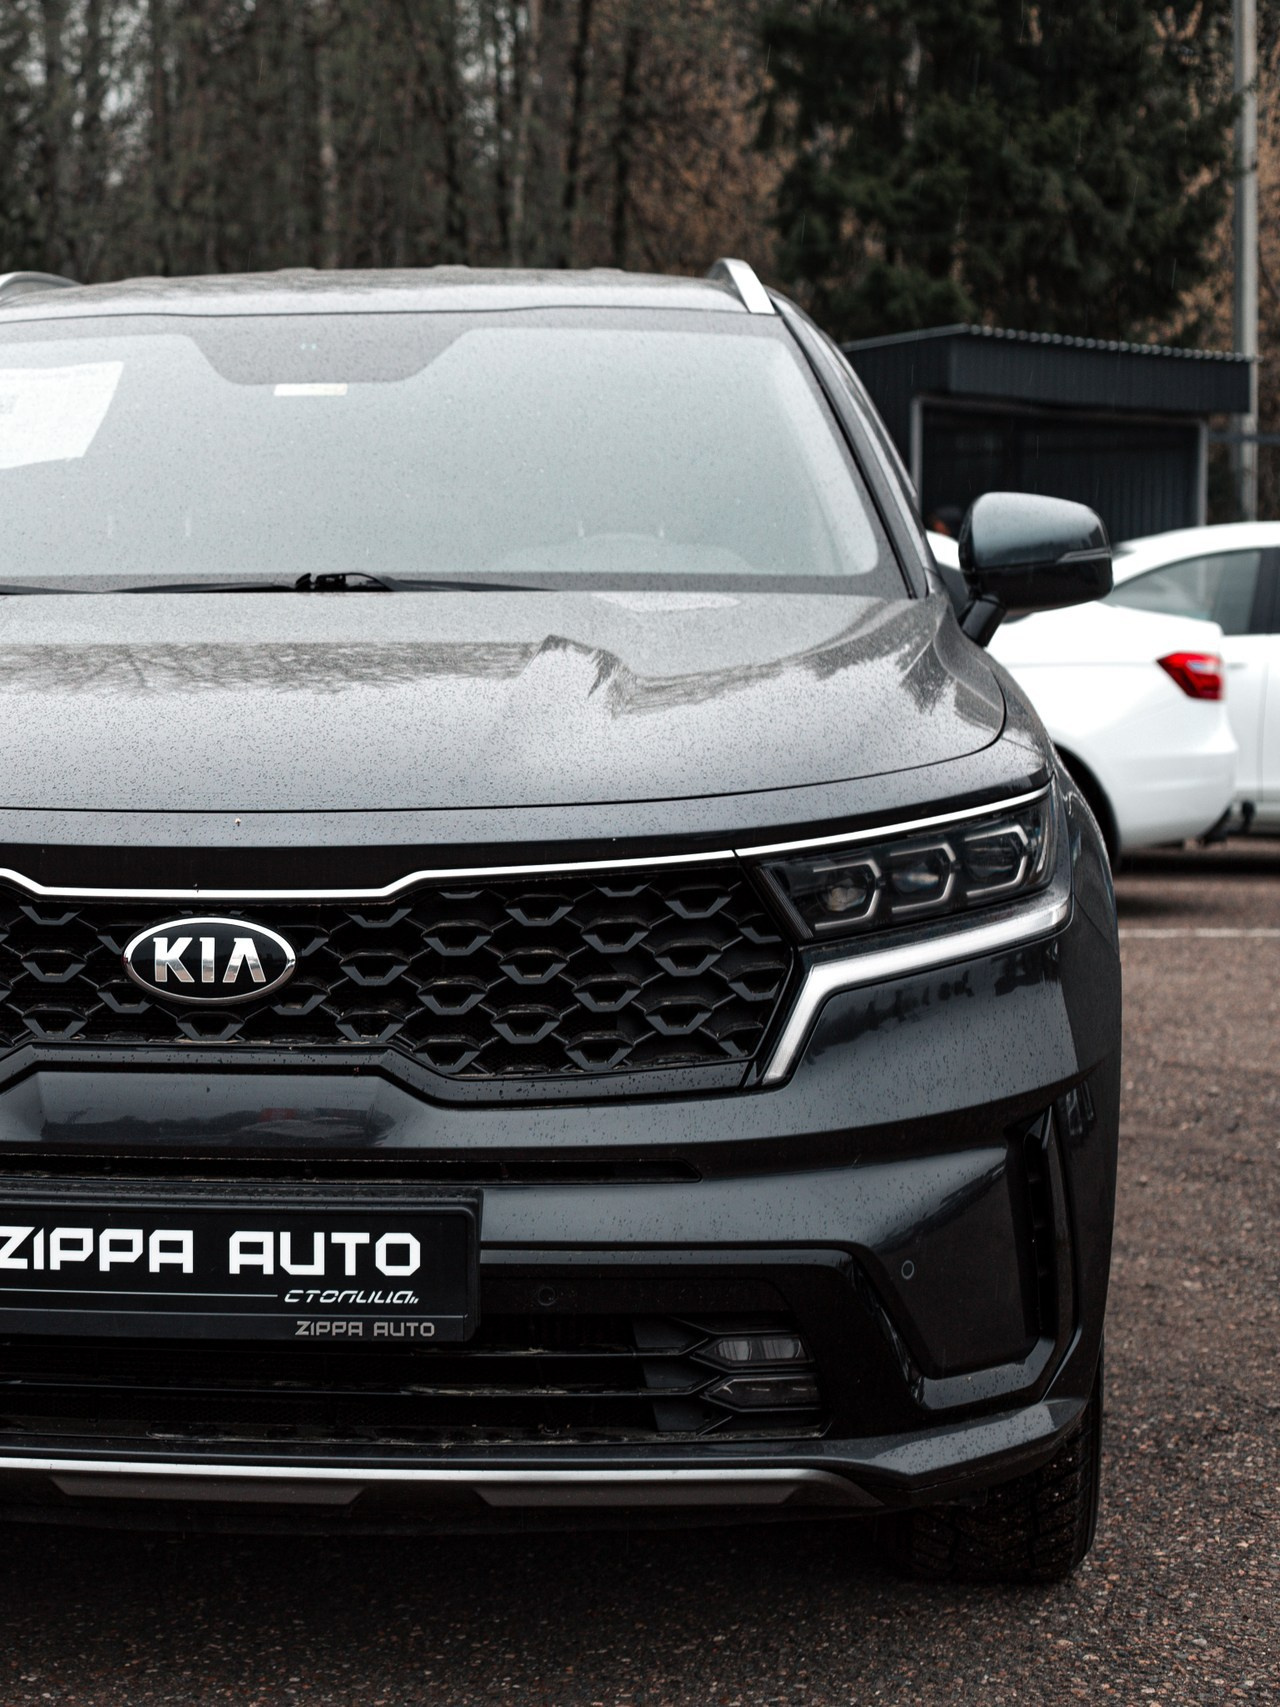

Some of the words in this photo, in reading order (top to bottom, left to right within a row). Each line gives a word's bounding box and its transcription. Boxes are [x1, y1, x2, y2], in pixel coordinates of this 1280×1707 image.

[153, 937, 266, 983] KIA
[228, 1230, 421, 1277] AUTO
[294, 1320, 363, 1337] ZIPPA
[373, 1321, 435, 1337] AUTO
